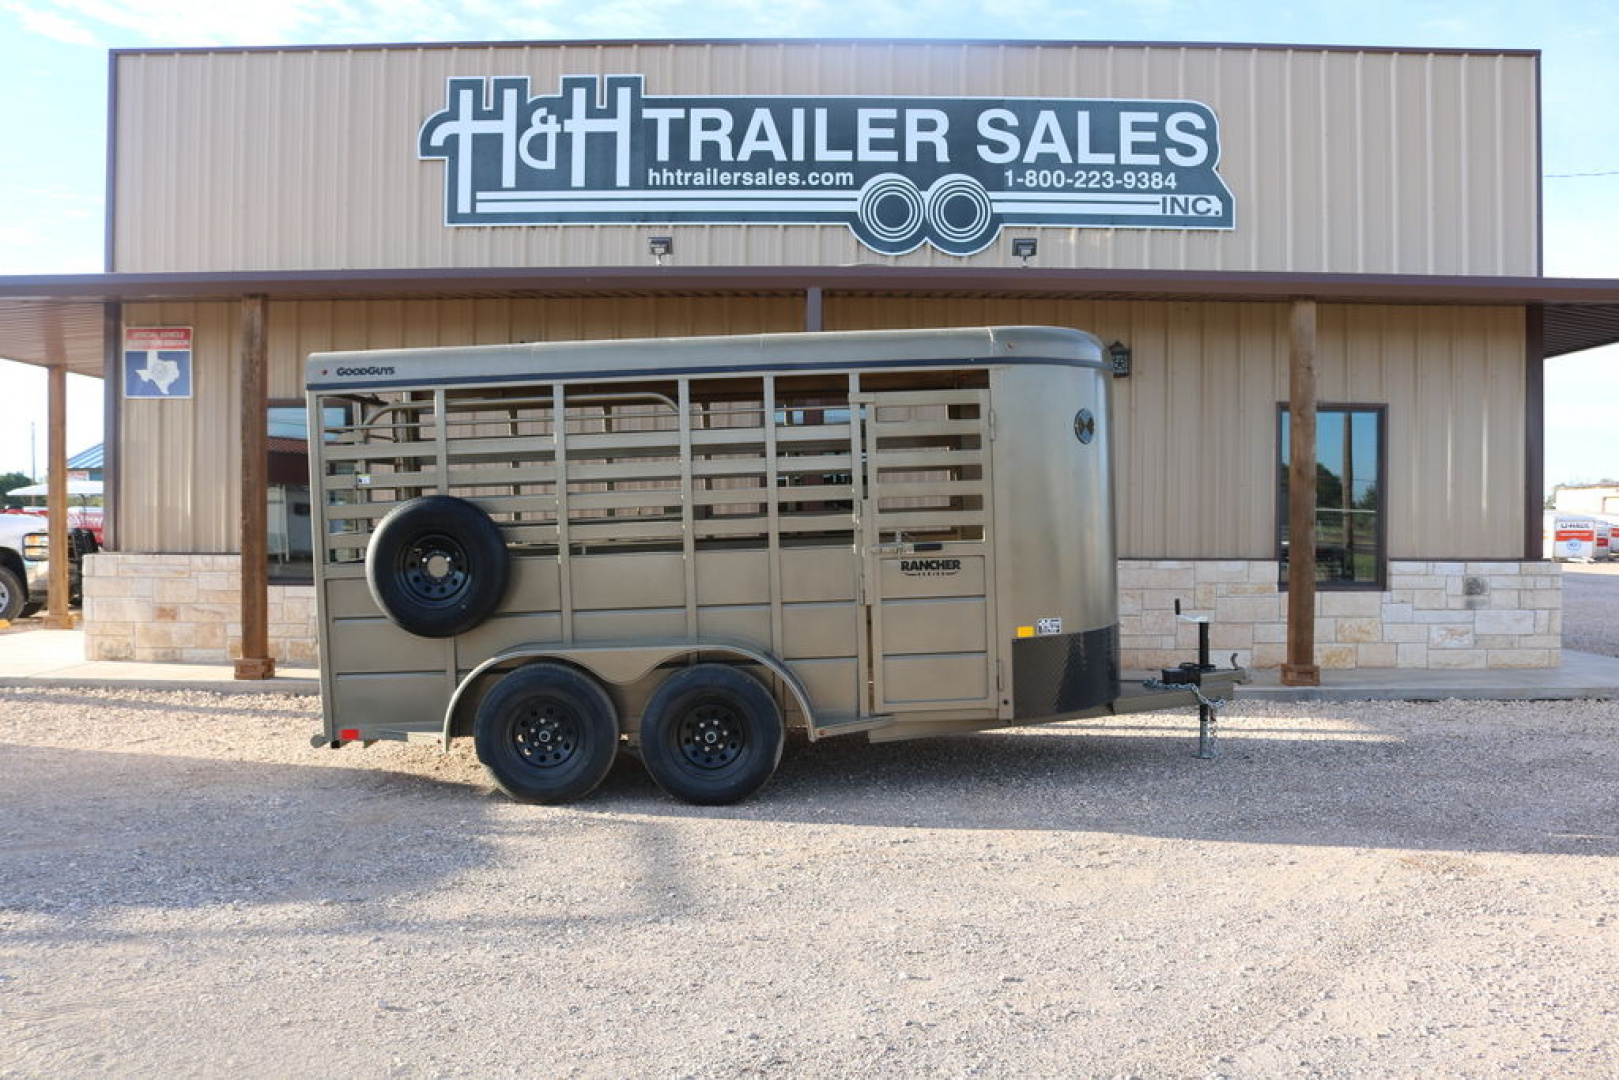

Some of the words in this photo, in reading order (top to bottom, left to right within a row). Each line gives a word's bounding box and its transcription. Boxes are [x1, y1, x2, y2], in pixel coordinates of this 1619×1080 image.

[430, 87, 632, 214] H&H
[642, 108, 950, 163] TRAILER
[976, 108, 1209, 167] SALES
[647, 168, 854, 187] hhtrailersales.com
[1004, 169, 1177, 190] 1-800-223-9384
[1161, 195, 1221, 216] INC.
[900, 559, 961, 571] RANCHER
